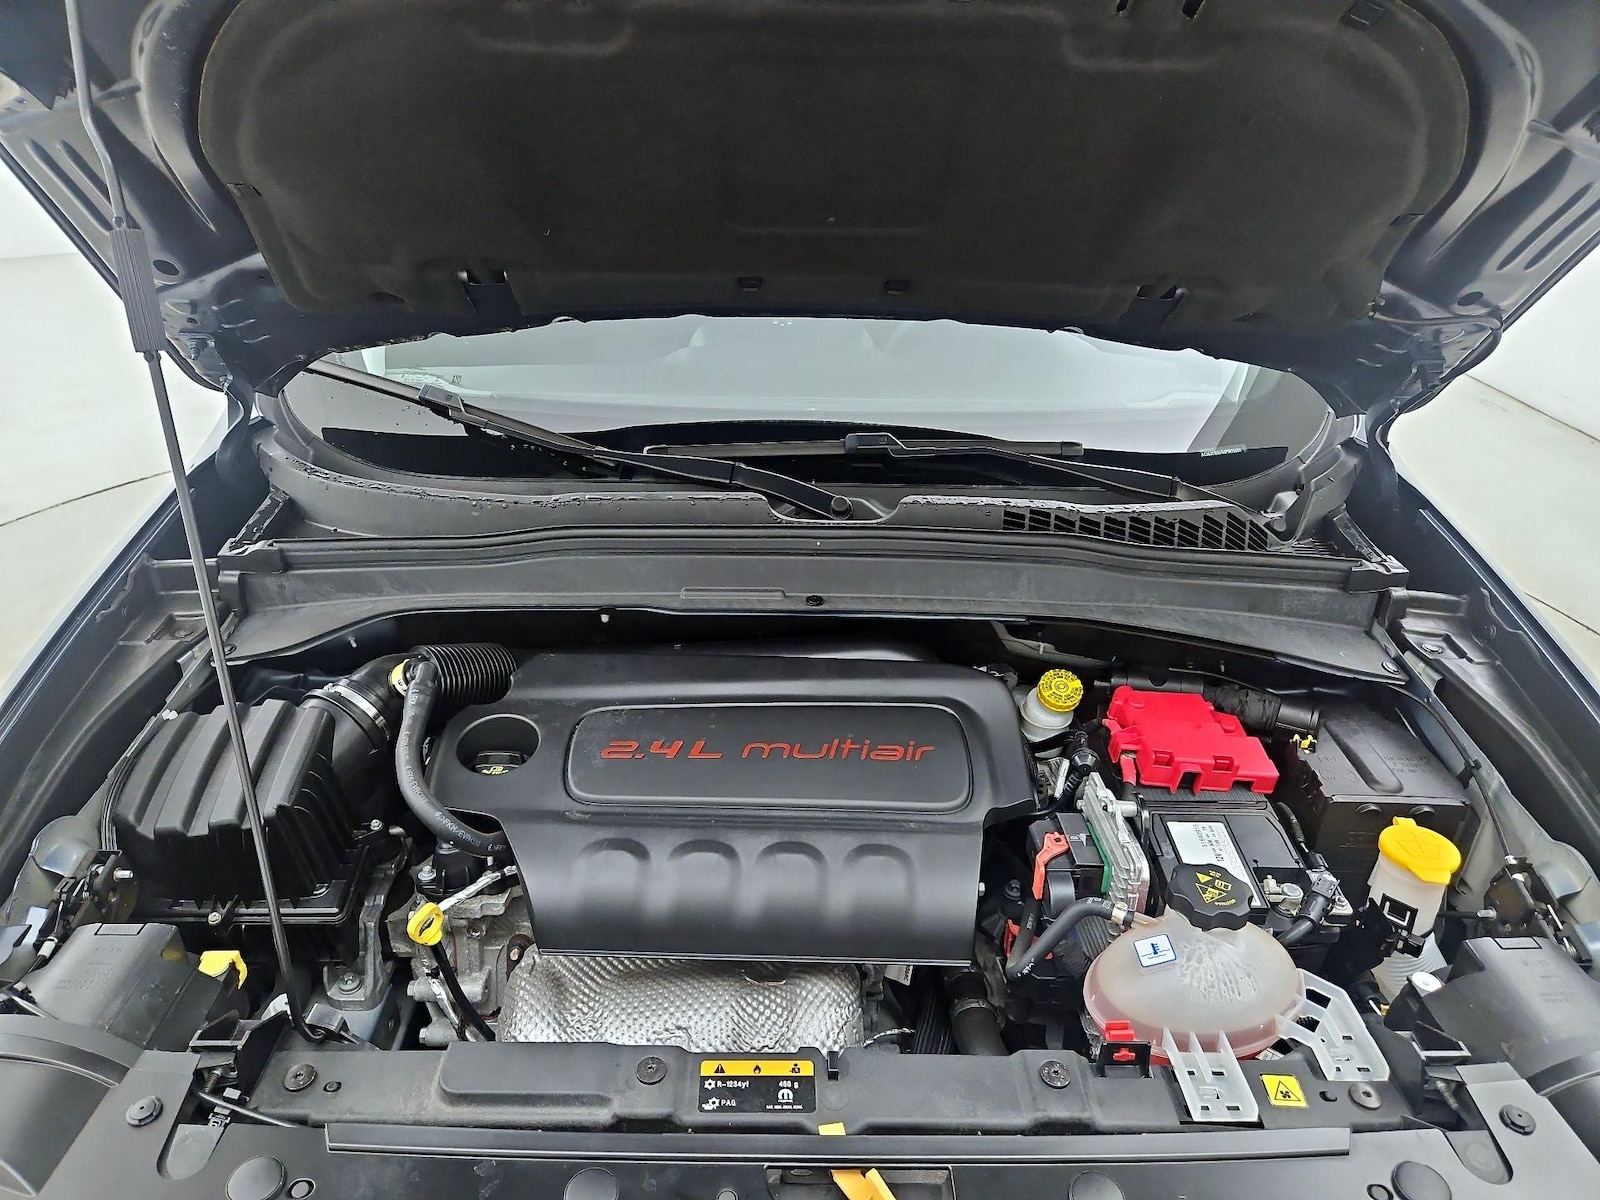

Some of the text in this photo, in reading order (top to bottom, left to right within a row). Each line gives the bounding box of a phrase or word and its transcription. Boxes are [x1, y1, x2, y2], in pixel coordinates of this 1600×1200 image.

[601, 738, 935, 761] 2.4 L multiair
[721, 1099, 736, 1107] PAG
